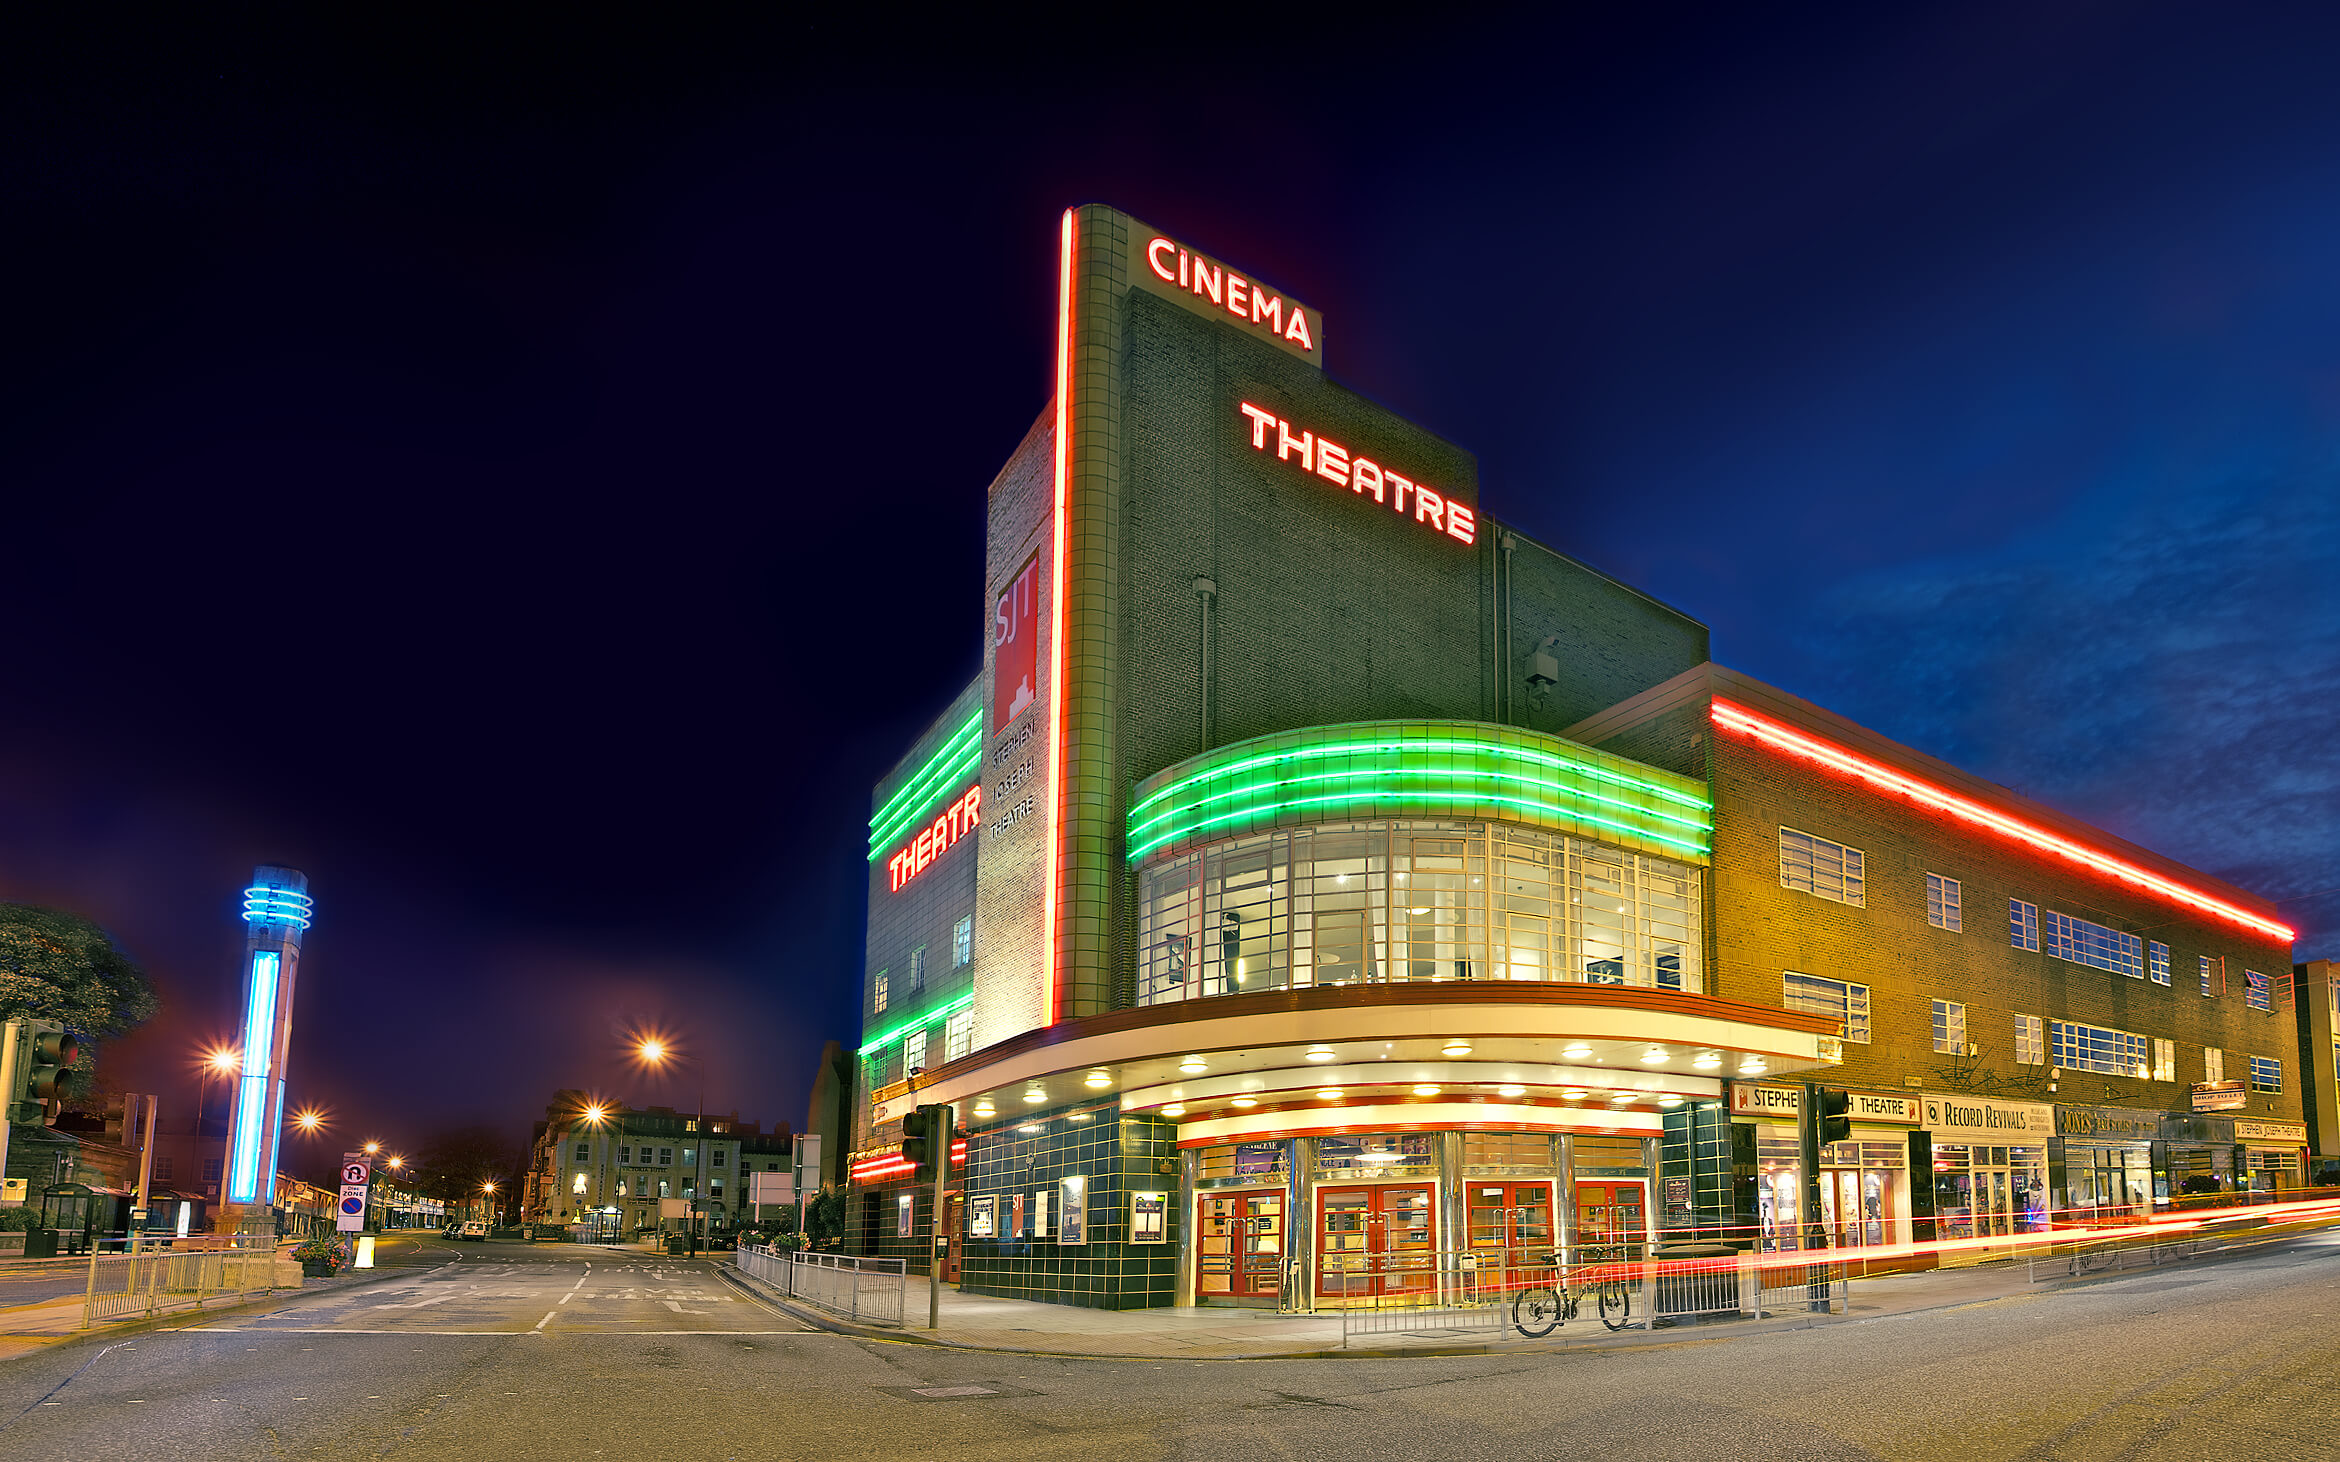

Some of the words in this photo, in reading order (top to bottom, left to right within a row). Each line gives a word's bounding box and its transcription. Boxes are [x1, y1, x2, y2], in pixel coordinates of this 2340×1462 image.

[1147, 236, 1313, 352] CINEMA
[1241, 401, 1476, 545] THEATRE
[996, 557, 1037, 647] SJT
[992, 718, 1036, 771] STEPHEN
[991, 755, 1034, 808] JOSEPH
[889, 784, 981, 893] THEATR
[990, 794, 1034, 840] THEATRE
[1754, 1088, 1798, 1108] STEPHE
[1860, 1097, 1904, 1115] THEATRE
[1945, 1101, 1983, 1127] RECORD
[1985, 1105, 2026, 1130] REVIVALS
[2241, 1123, 2263, 1135] STEPHEN
[2264, 1125, 2280, 1137] JOSEPH
[2281, 1126, 2301, 1137] THEATRE
[1012, 1193, 1025, 1211] SJT
